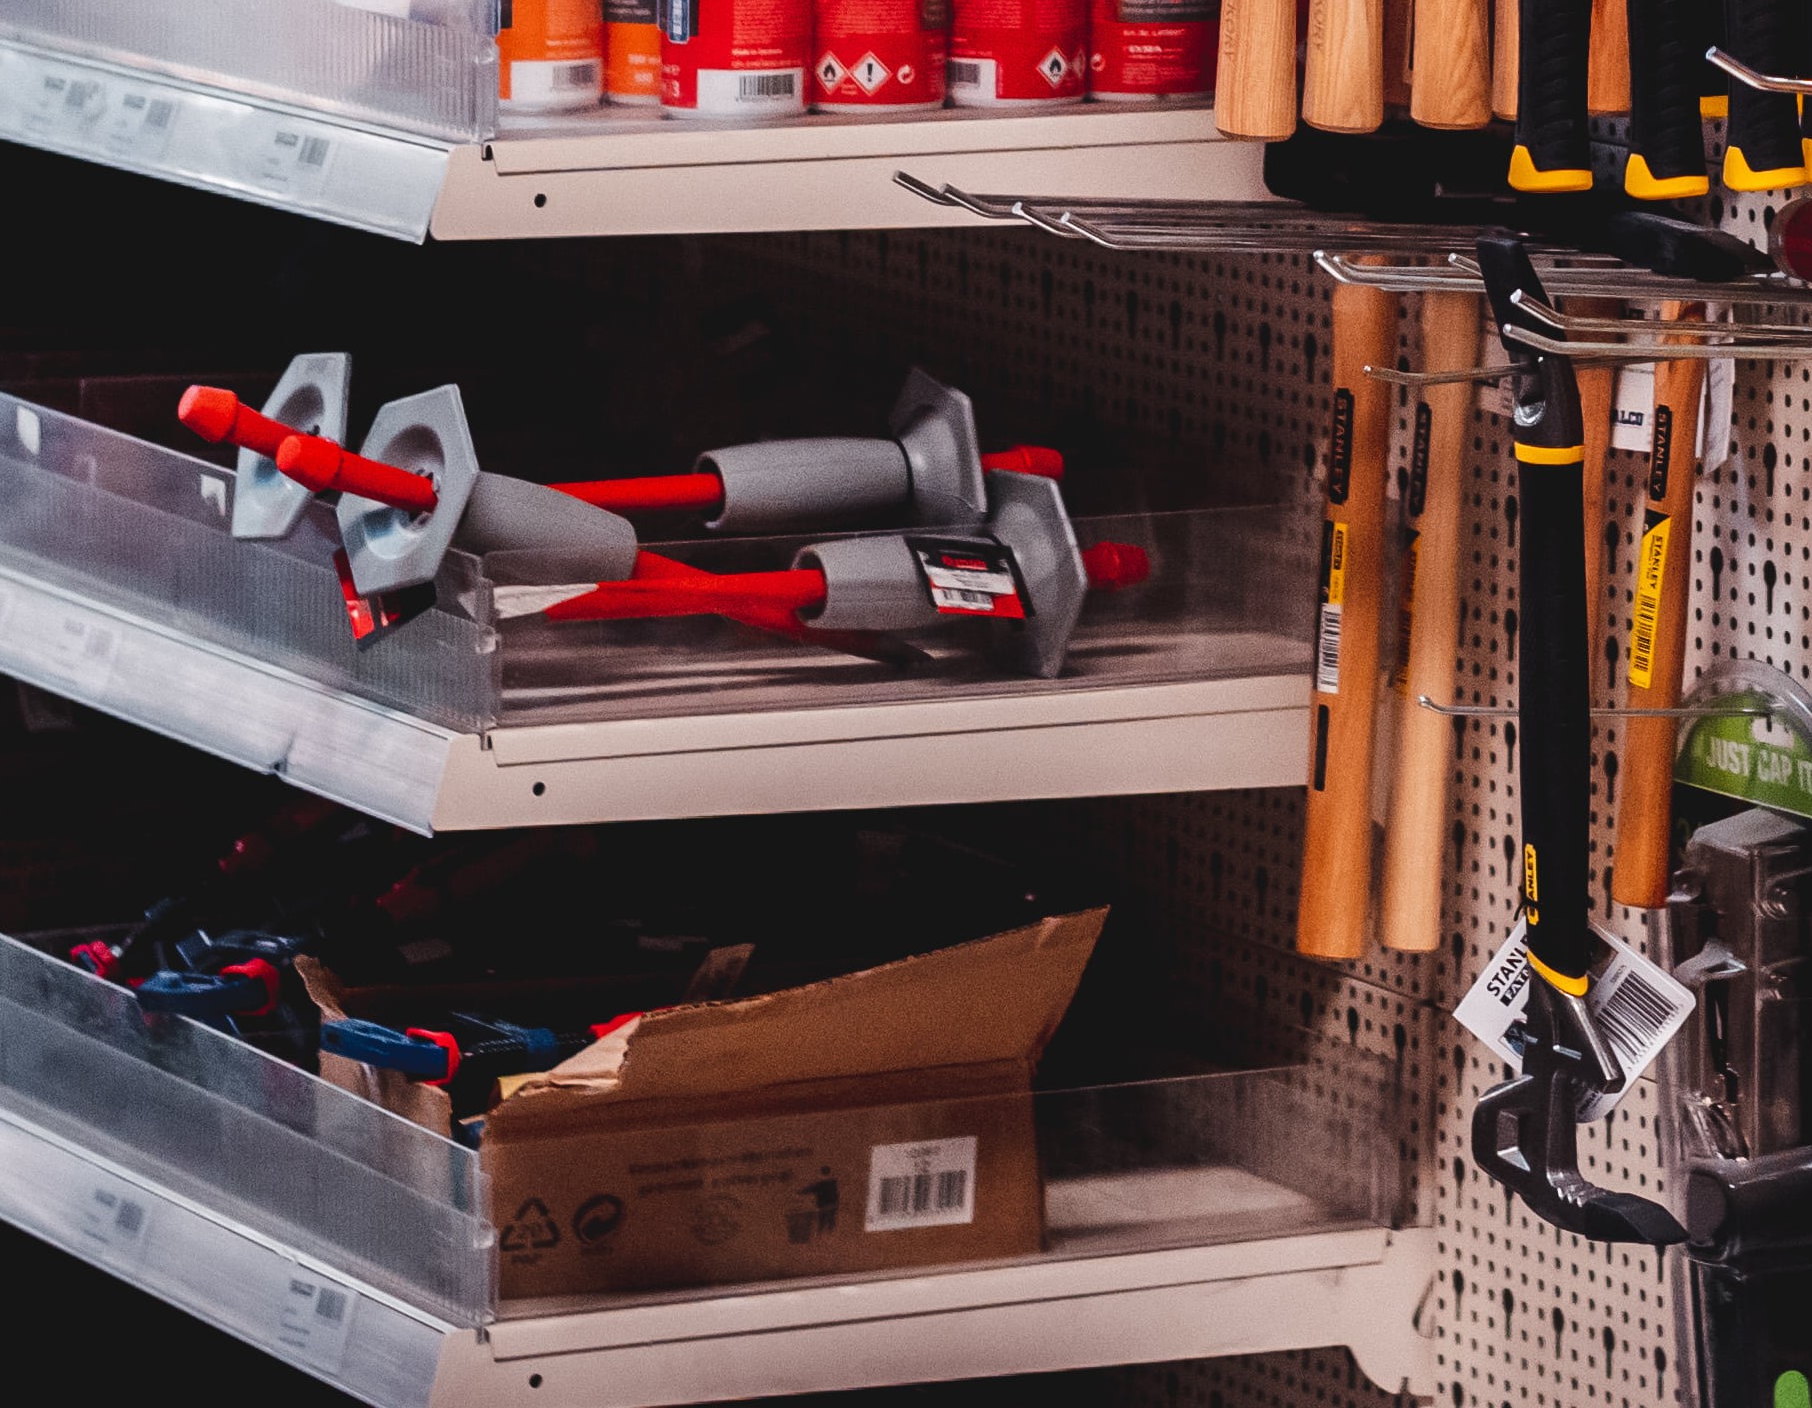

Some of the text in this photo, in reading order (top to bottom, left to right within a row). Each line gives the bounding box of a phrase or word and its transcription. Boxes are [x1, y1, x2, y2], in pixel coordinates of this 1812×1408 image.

[1652, 410, 1669, 495] STANLEY
[1650, 535, 1665, 590] STANLEY
[1708, 737, 1750, 776] JUST
[1756, 749, 1790, 788] CAP
